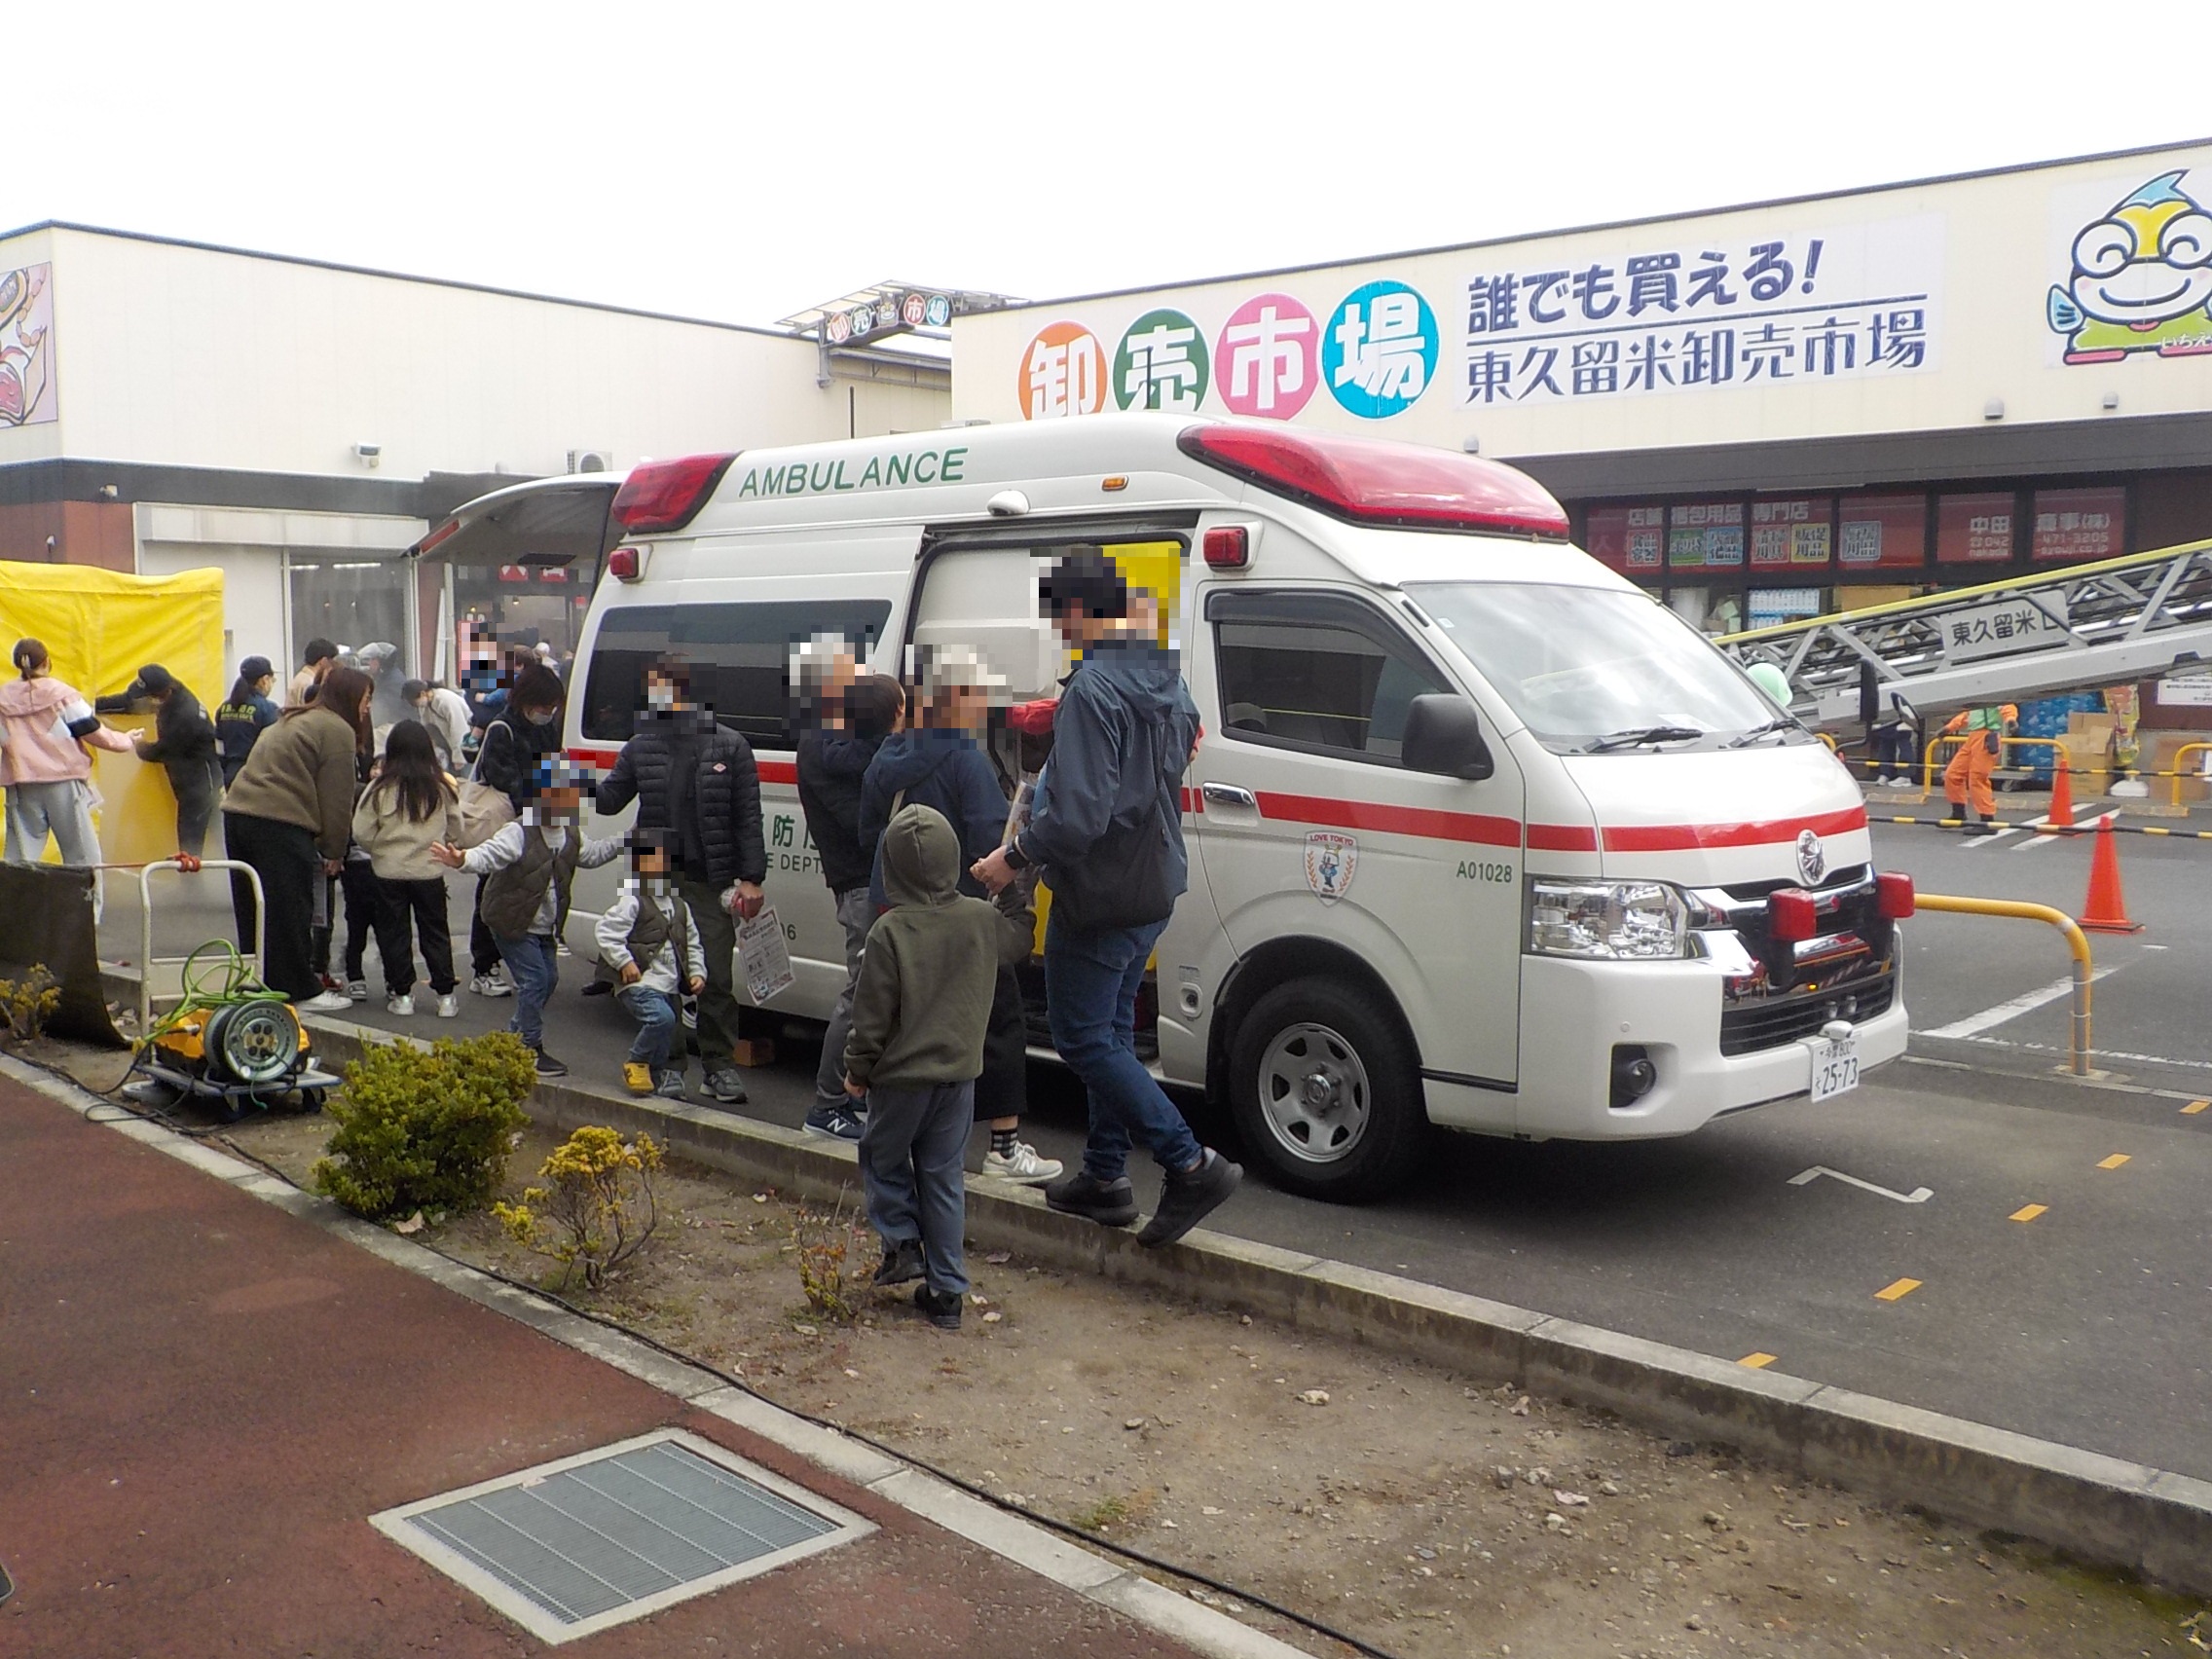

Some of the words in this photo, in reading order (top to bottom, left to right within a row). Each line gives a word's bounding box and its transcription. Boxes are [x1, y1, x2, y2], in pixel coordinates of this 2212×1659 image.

[1467, 239, 1825, 334] 誰でも買える!
[1029, 292, 1425, 420] 卸売市場
[1465, 309, 1927, 404] 東久留米卸売市場
[2161, 332, 2212, 349] いちえ
[739, 447, 969, 498] AMBULANCE
[1309, 833, 1329, 843] LOVE
[1329, 834, 1354, 846] TOKYO
[1456, 860, 1513, 883] A01028
